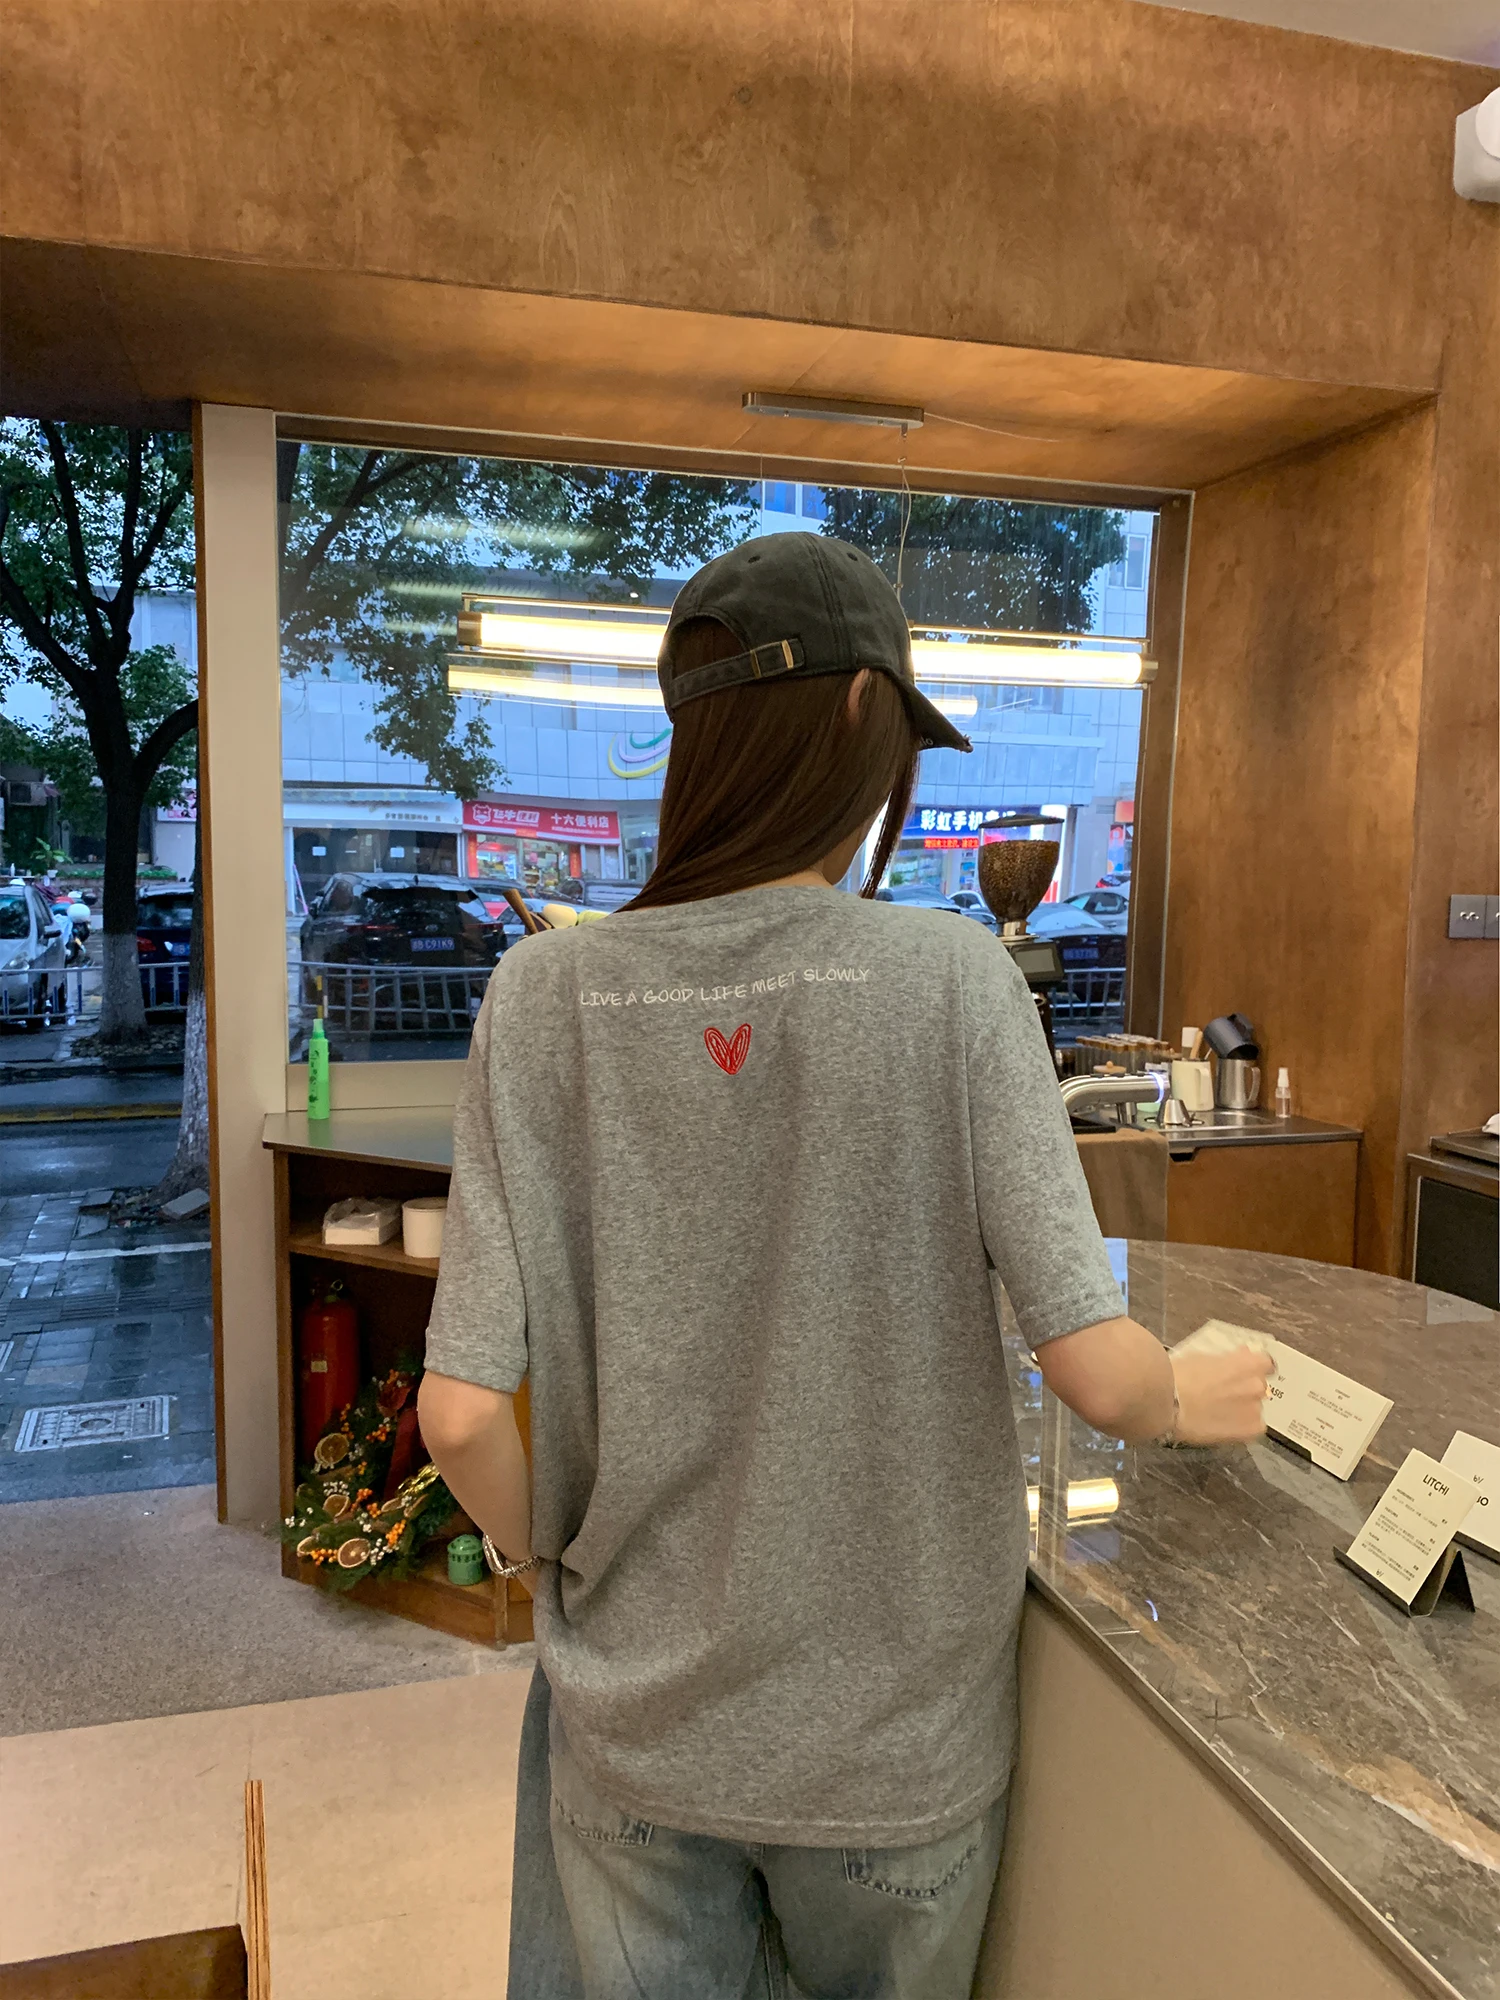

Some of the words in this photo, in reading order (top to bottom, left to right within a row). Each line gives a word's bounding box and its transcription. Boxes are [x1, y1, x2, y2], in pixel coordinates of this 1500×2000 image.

[550, 812, 609, 829] 十六便利店
[580, 989, 622, 1006] LIVE
[625, 990, 638, 1006] A
[643, 988, 694, 1004] GOOD
[700, 984, 748, 1001] LIFE
[751, 970, 796, 994] MEET
[803, 967, 870, 982] SLOWLY
[1422, 1473, 1450, 1496] LITCHI
